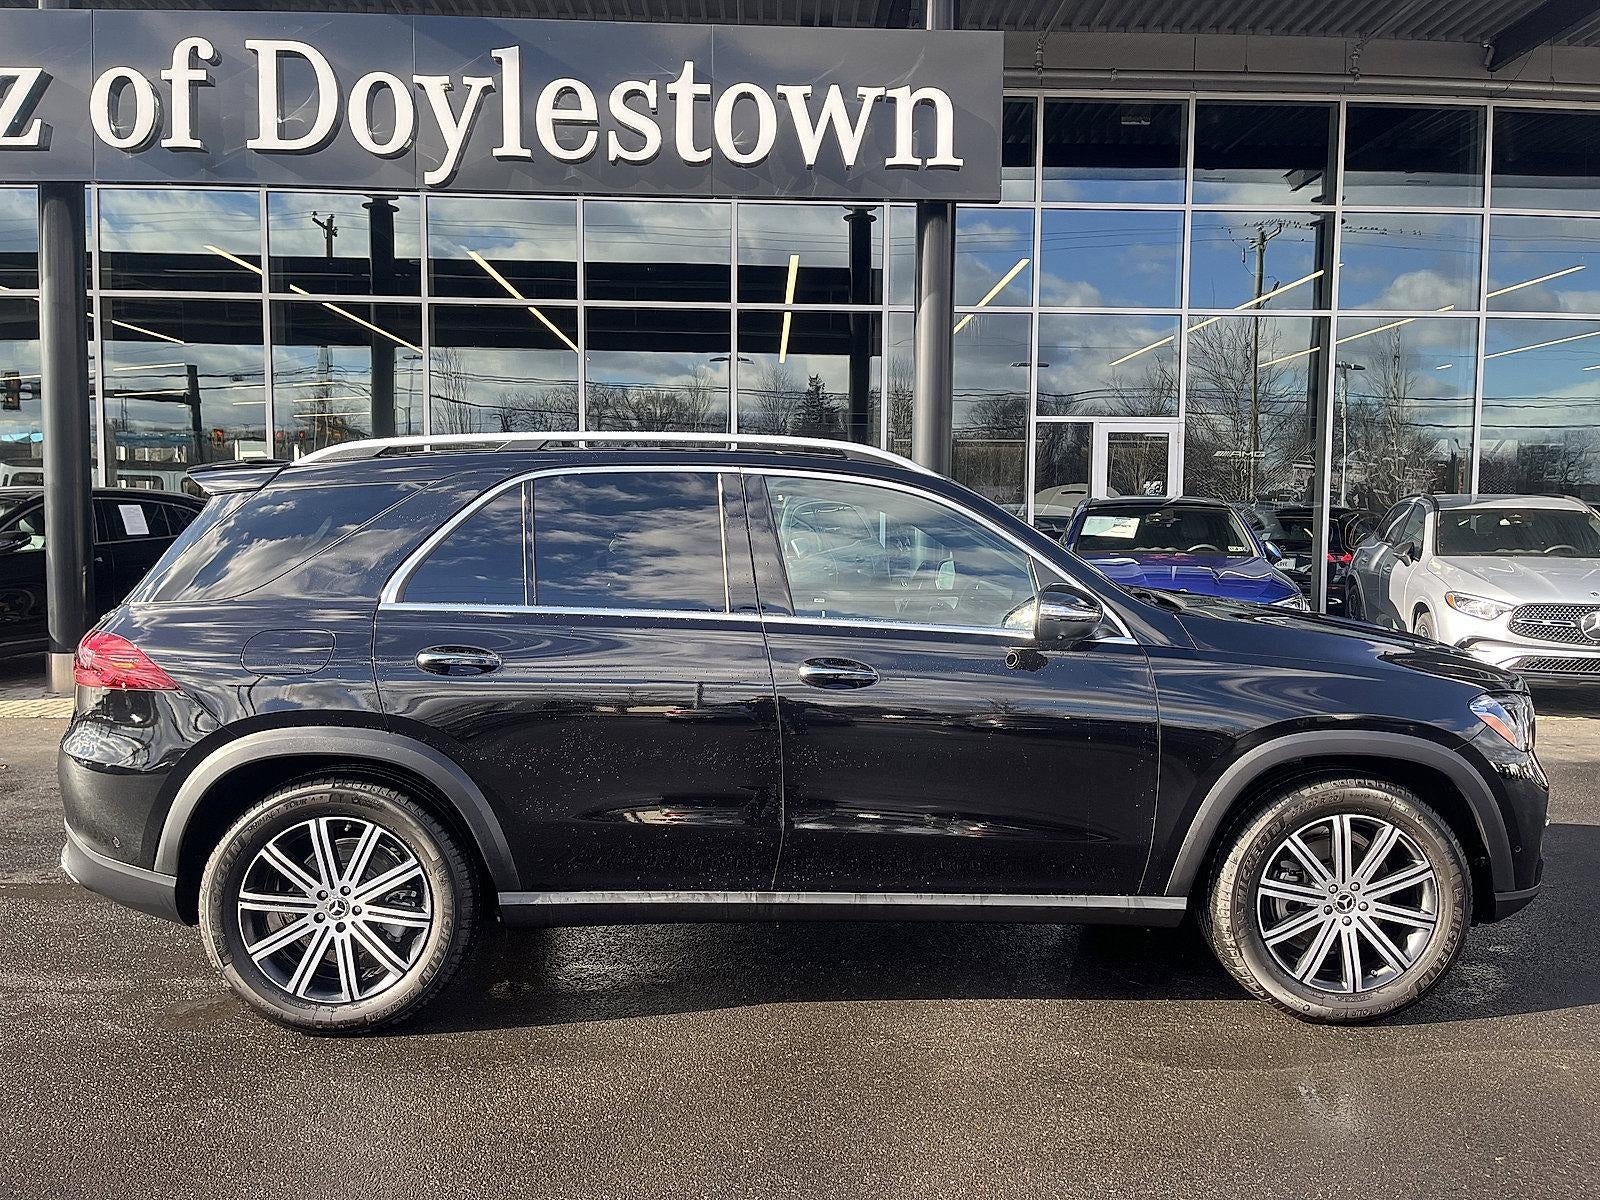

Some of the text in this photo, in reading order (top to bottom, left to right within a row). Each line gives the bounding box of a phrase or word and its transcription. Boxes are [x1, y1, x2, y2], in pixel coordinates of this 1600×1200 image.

[89, 36, 213, 151] of
[244, 38, 965, 187] Doylestown
[1229, 450, 1266, 458] AMG
[1237, 820, 1281, 906] MICHELIN
[420, 888, 454, 981] MICHELIN
[1418, 905, 1463, 989] MICHELIN
